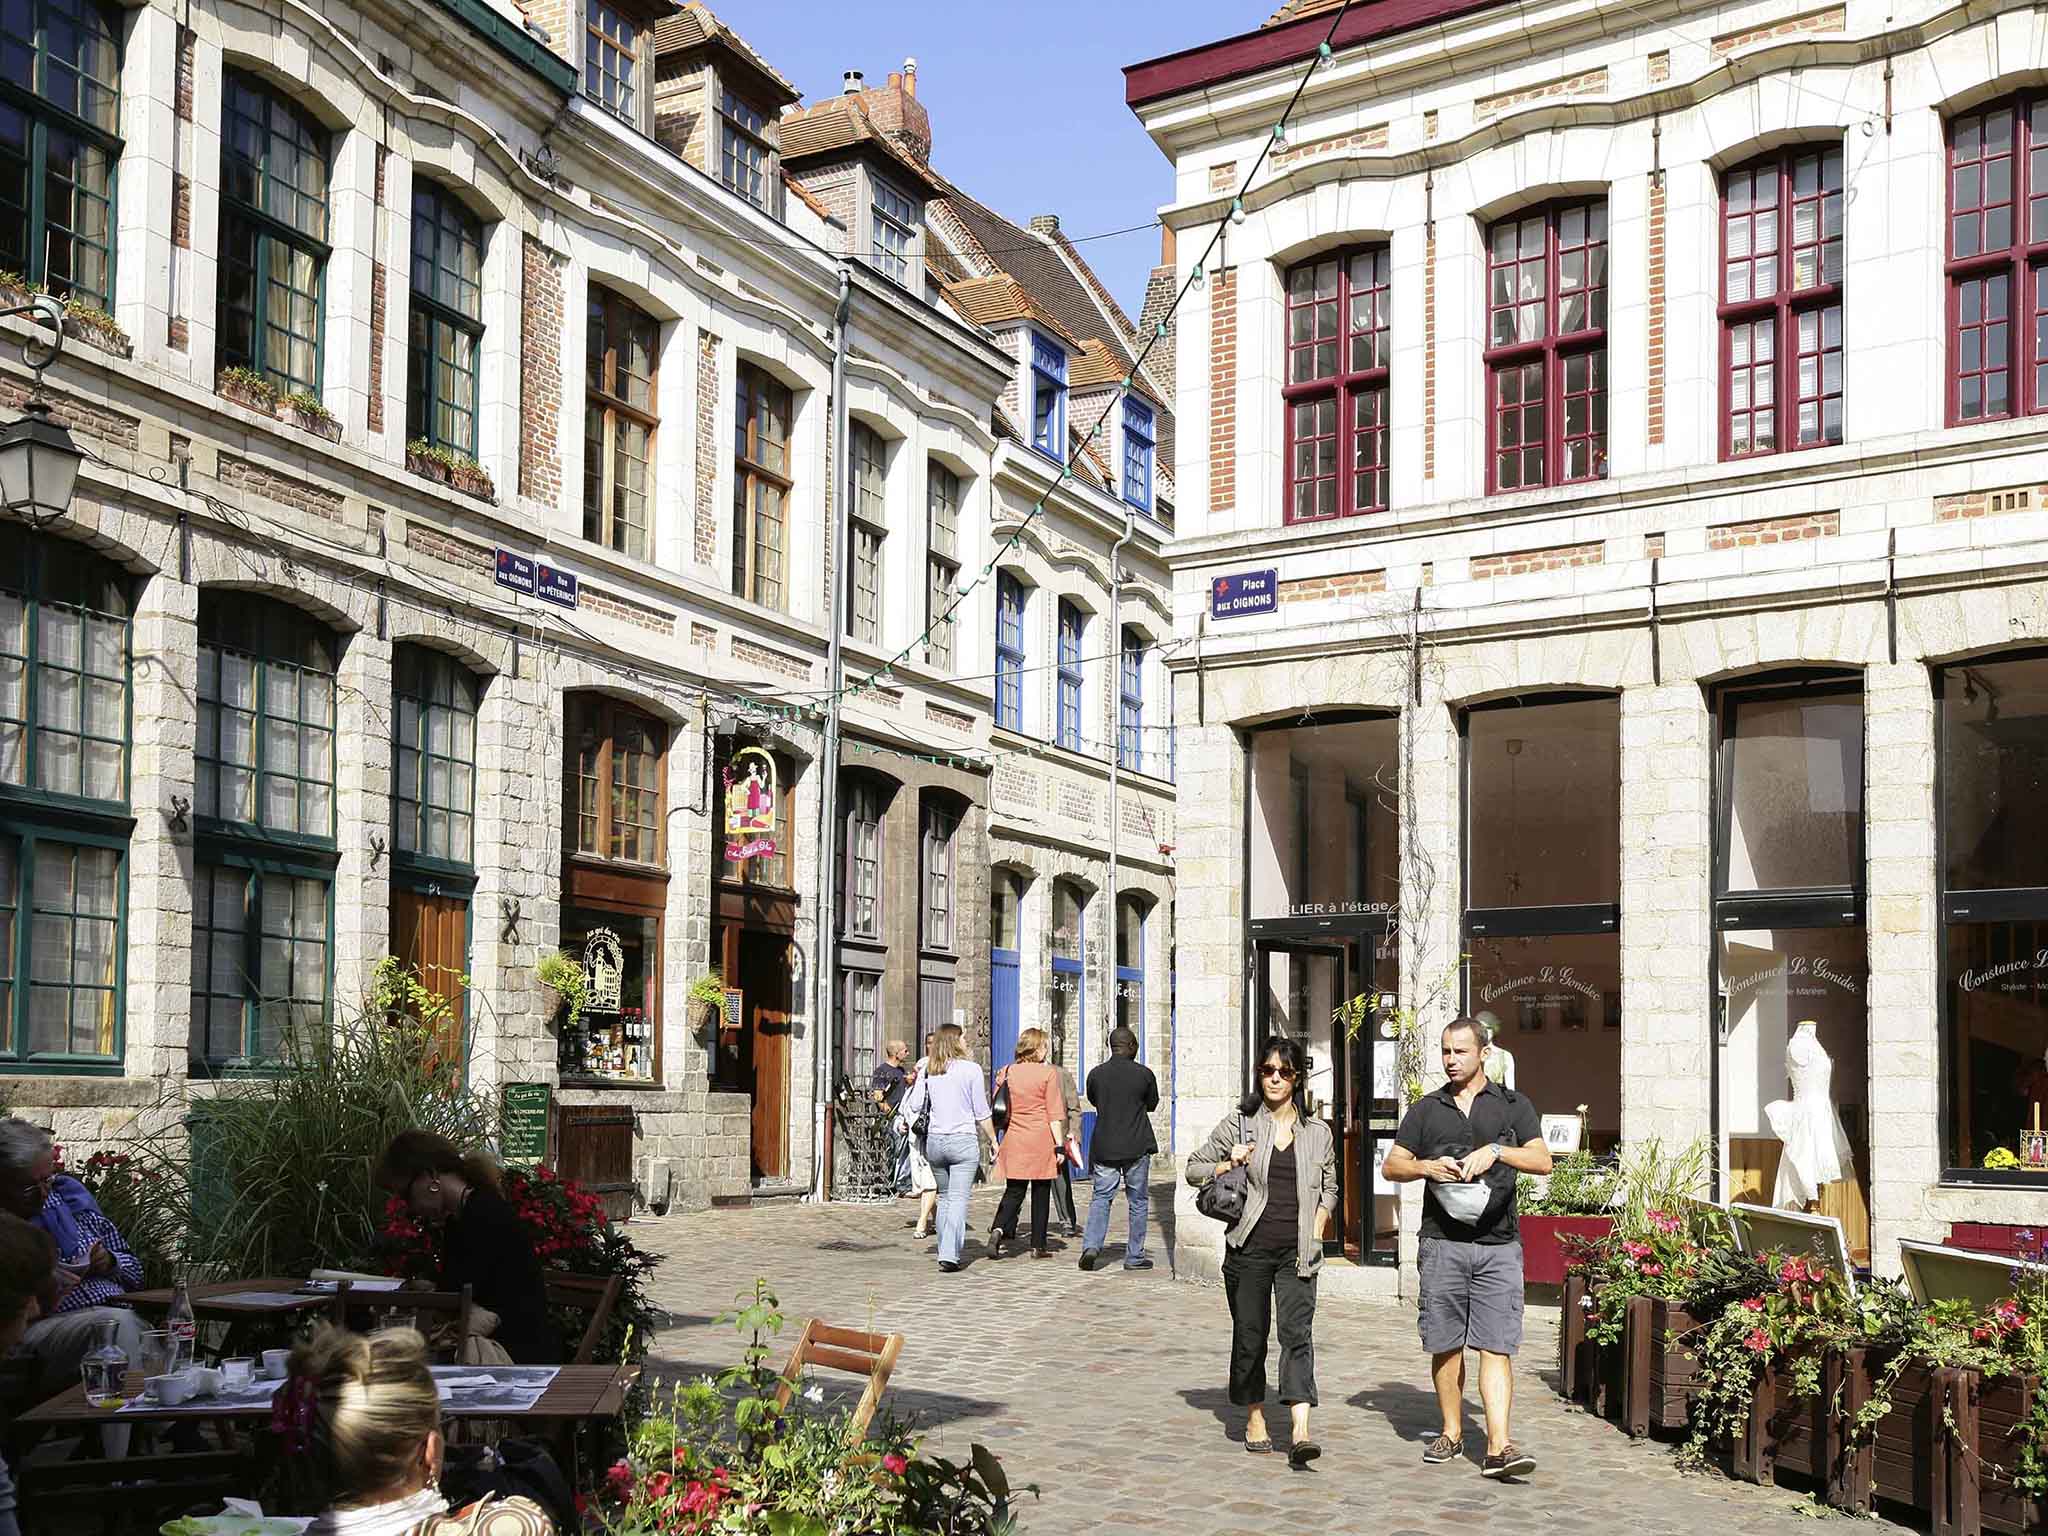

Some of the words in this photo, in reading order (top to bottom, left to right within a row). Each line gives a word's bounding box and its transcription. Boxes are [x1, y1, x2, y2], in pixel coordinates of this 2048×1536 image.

[514, 561, 529, 573] Place
[498, 571, 508, 581] aux
[508, 574, 532, 589] OIGNONS
[557, 575, 568, 587] Rue
[1242, 579, 1265, 590] Place
[546, 584, 575, 602] PÉTERINCK
[1216, 601, 1231, 611] aux
[1232, 593, 1272, 608] OIGNONS
[1329, 902, 1337, 912] à
[1341, 901, 1389, 913] l'étage
[1480, 975, 1536, 1003] Constance
[1537, 965, 1555, 984] Le
[1559, 965, 1601, 1001] Gonidec
[1723, 967, 1786, 997] Constance
[1790, 956, 1808, 976] Le
[1958, 959, 2030, 992] Constance
